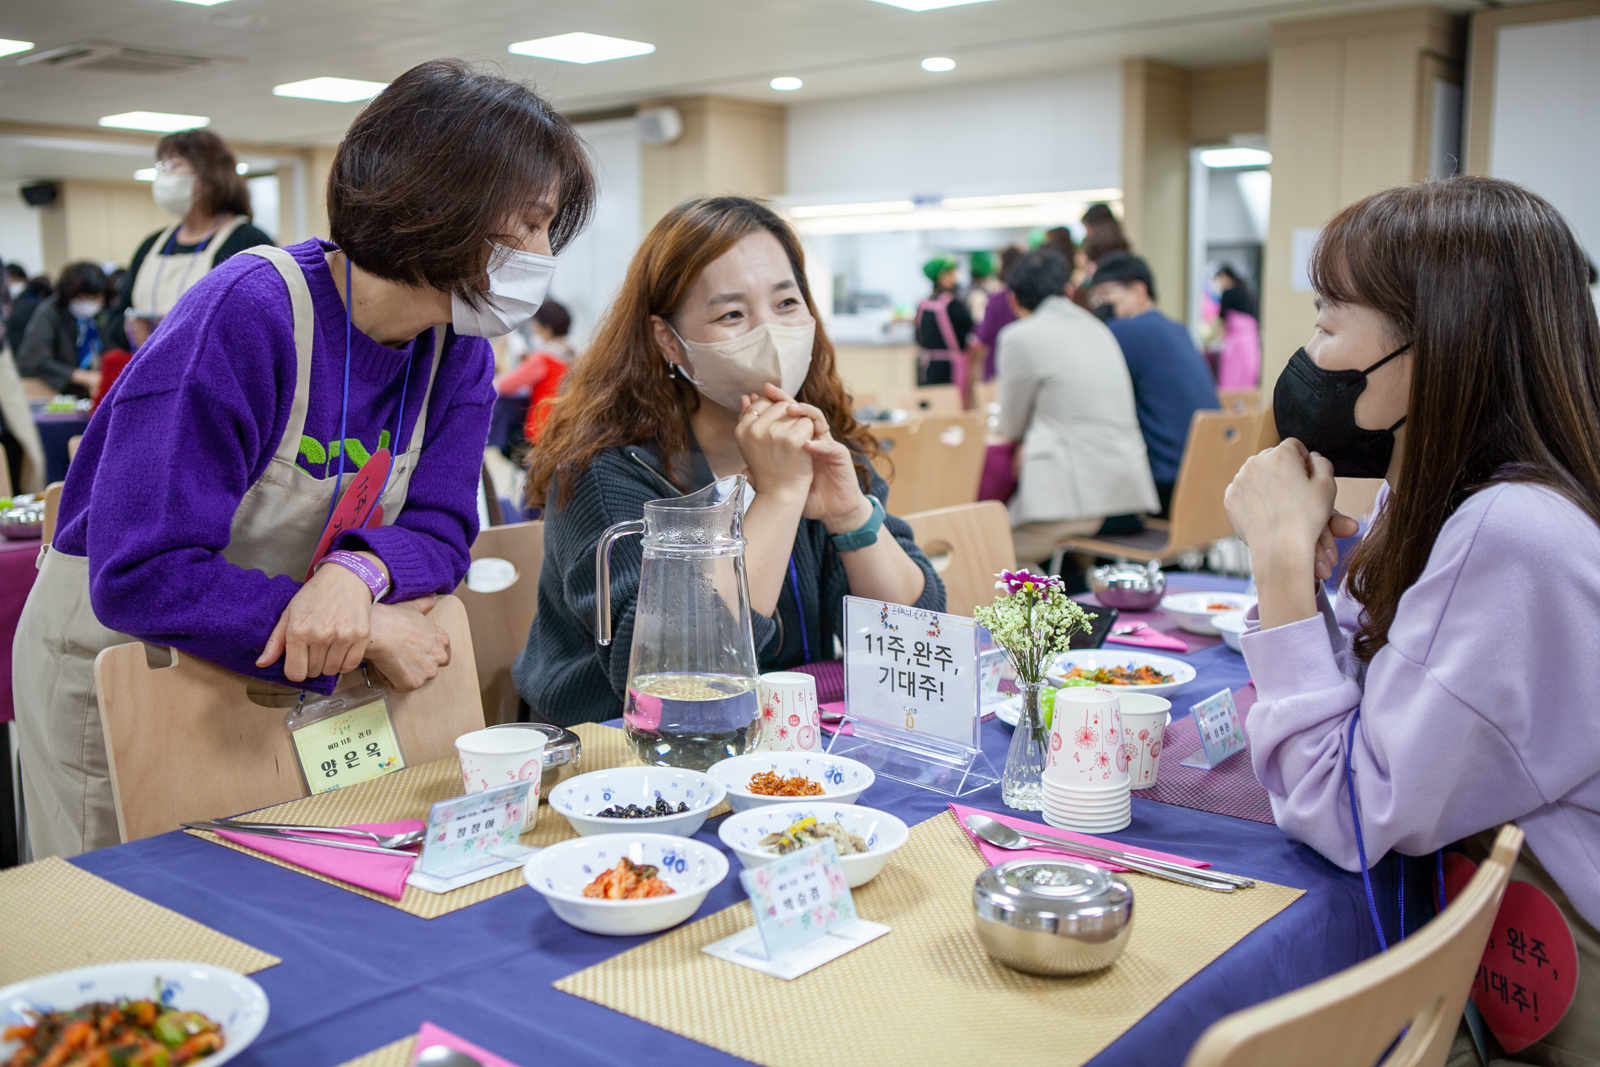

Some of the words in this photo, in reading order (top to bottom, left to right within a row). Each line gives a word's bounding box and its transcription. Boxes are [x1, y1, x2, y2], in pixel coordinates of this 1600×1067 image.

[878, 666, 944, 703] 기대주!
[340, 736, 352, 746] 11조
[1506, 927, 1558, 980] 완주,
